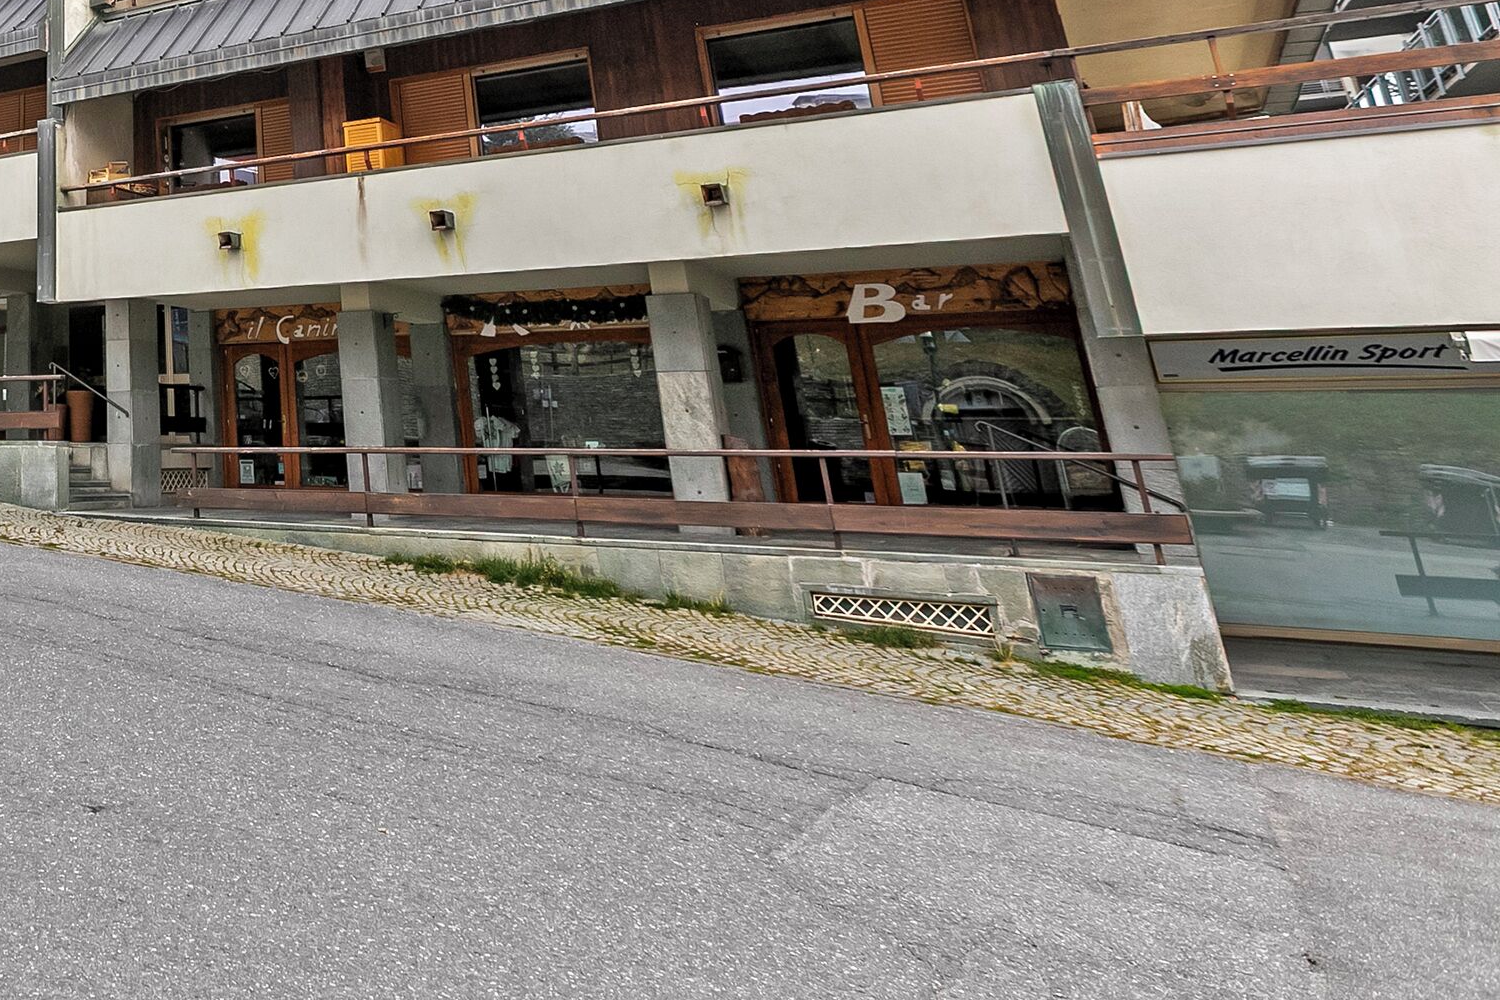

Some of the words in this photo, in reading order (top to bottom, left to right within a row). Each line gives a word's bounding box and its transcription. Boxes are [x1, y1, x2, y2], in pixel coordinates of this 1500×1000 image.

[845, 283, 954, 324] Bar
[247, 316, 265, 340] il
[1208, 345, 1349, 364] Marcellin
[1358, 343, 1449, 364] Sport
